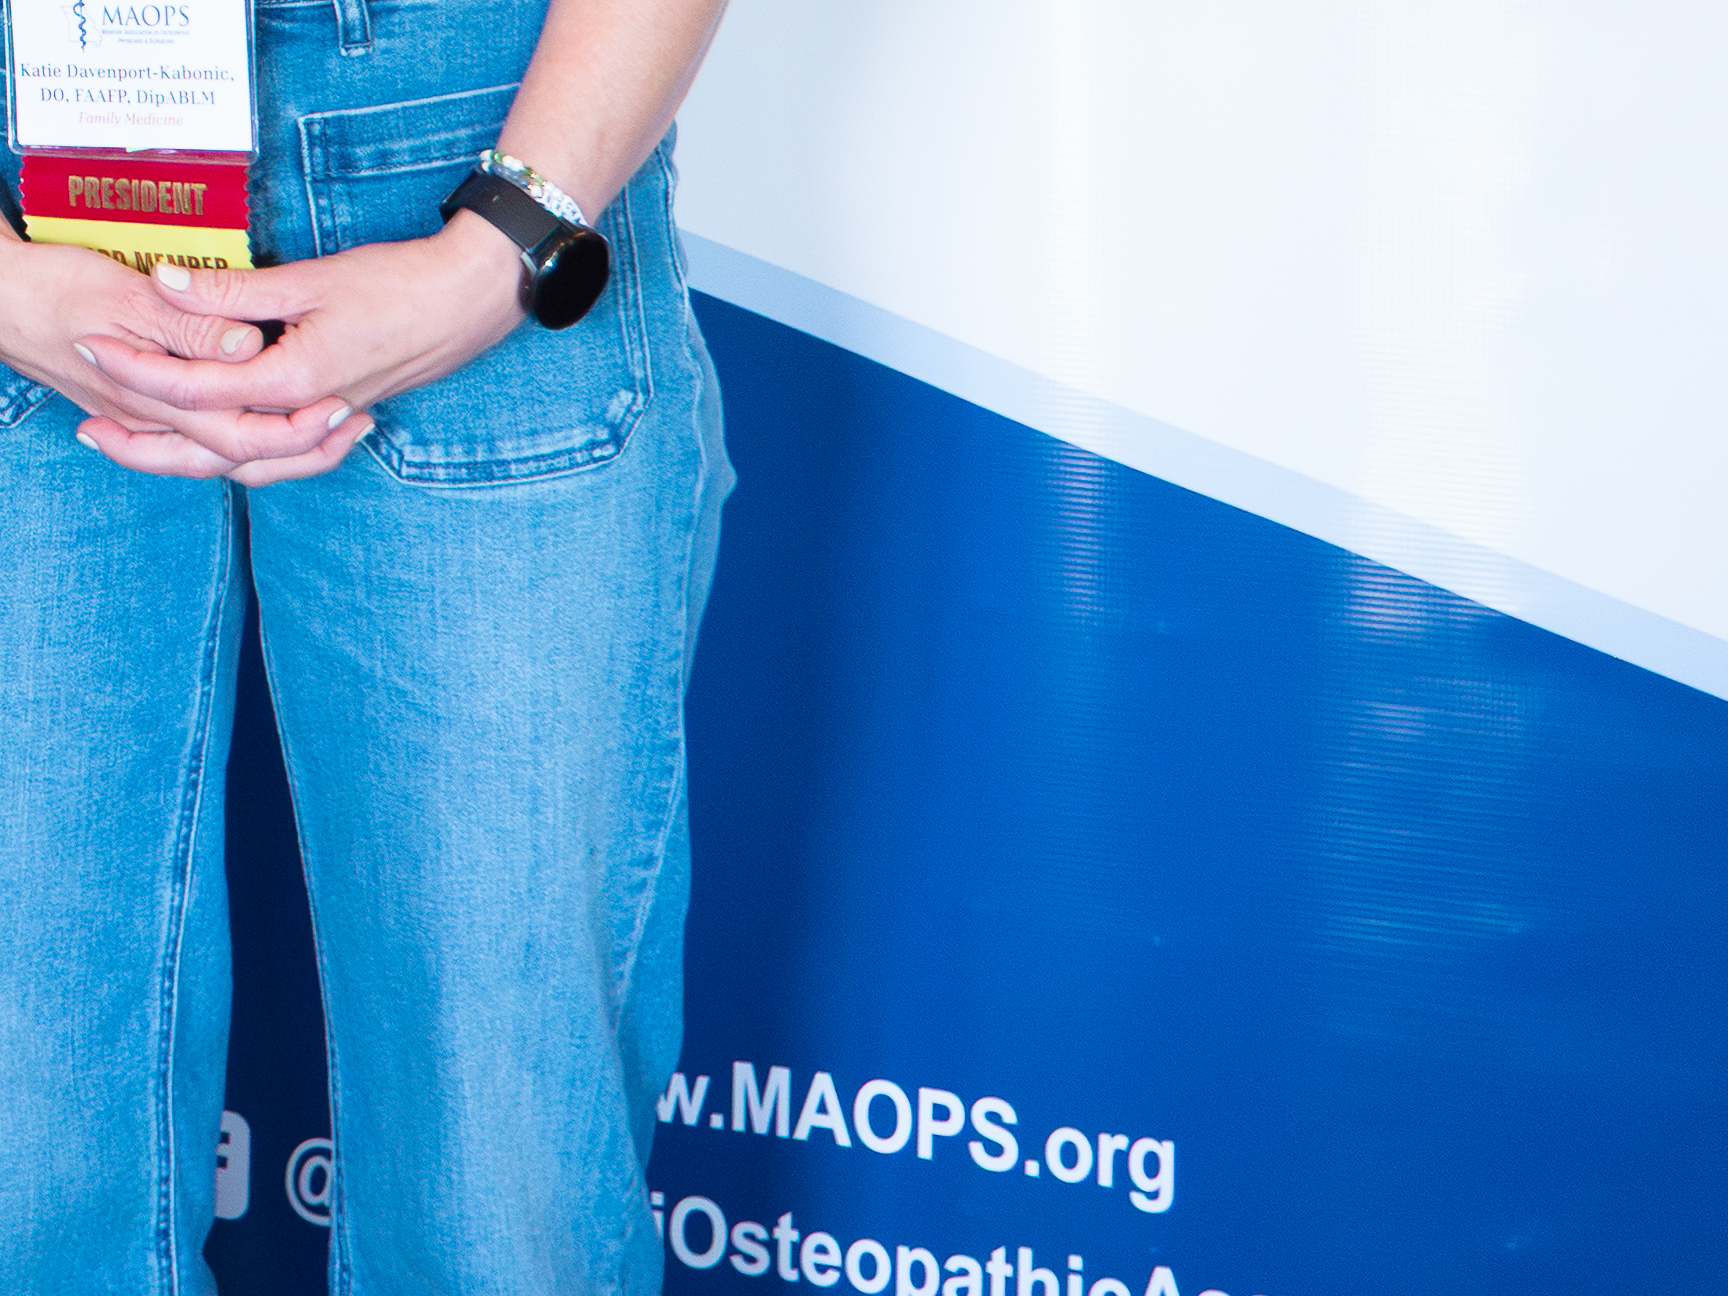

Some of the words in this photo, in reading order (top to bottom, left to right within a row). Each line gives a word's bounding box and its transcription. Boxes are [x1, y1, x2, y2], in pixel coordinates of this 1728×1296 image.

[102, 5, 189, 26] MAOPS
[20, 63, 61, 78] Katie
[67, 64, 235, 82] Davenport-Kabonic,
[41, 87, 69, 103] DO,
[75, 88, 131, 105] FAAFP,
[137, 89, 216, 107] DipABLM
[79, 112, 121, 127] Family
[125, 113, 184, 126] Medicine
[68, 175, 207, 215] PRESIDENT
